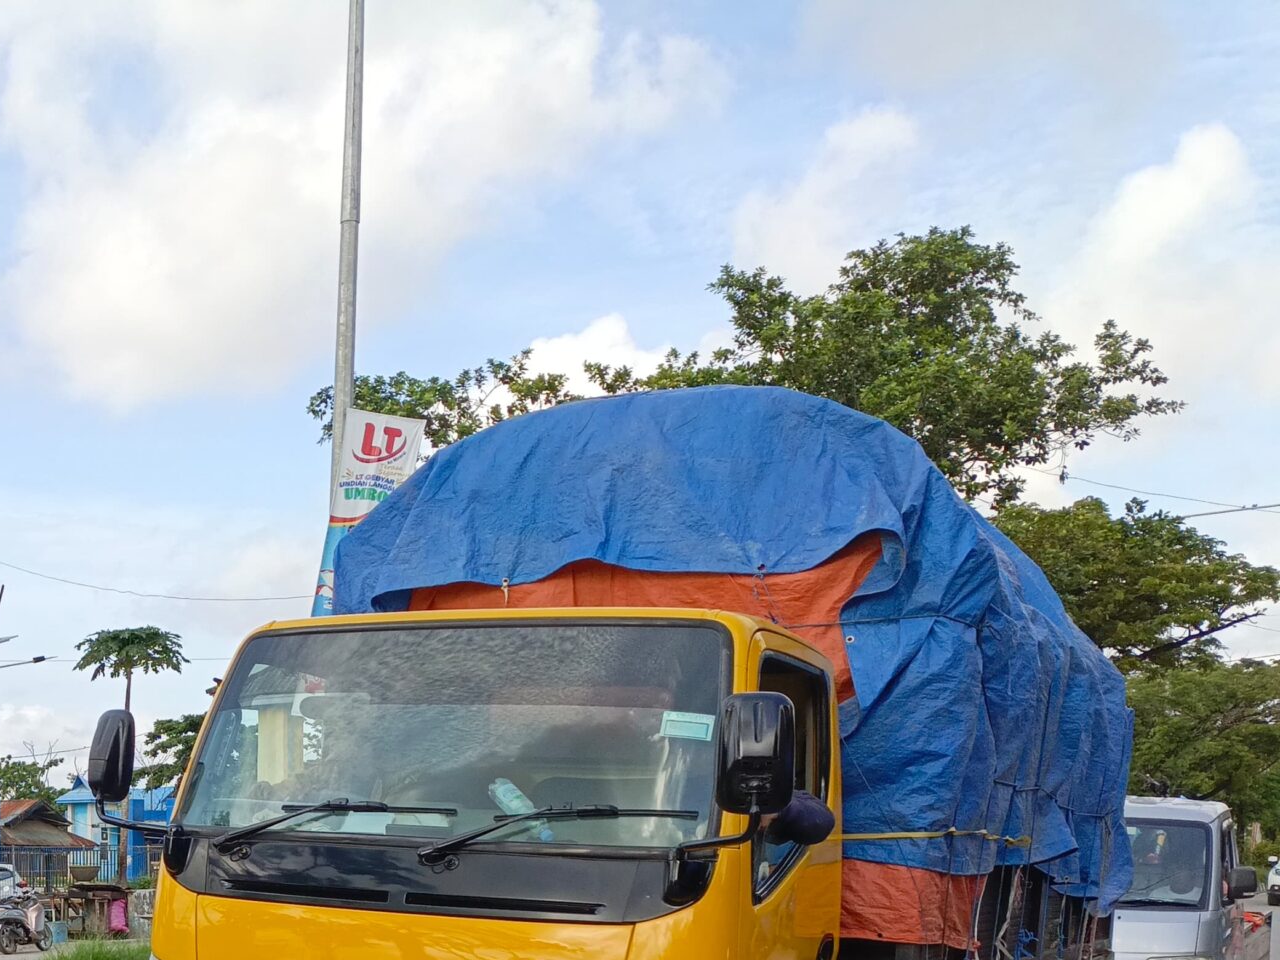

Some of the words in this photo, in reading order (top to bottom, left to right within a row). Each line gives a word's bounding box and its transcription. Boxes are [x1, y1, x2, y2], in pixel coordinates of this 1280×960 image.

[361, 422, 402, 457] LT
[339, 480, 368, 488] UNDIAN
[365, 474, 395, 485] GEBYAR
[344, 487, 388, 502] UMRO
